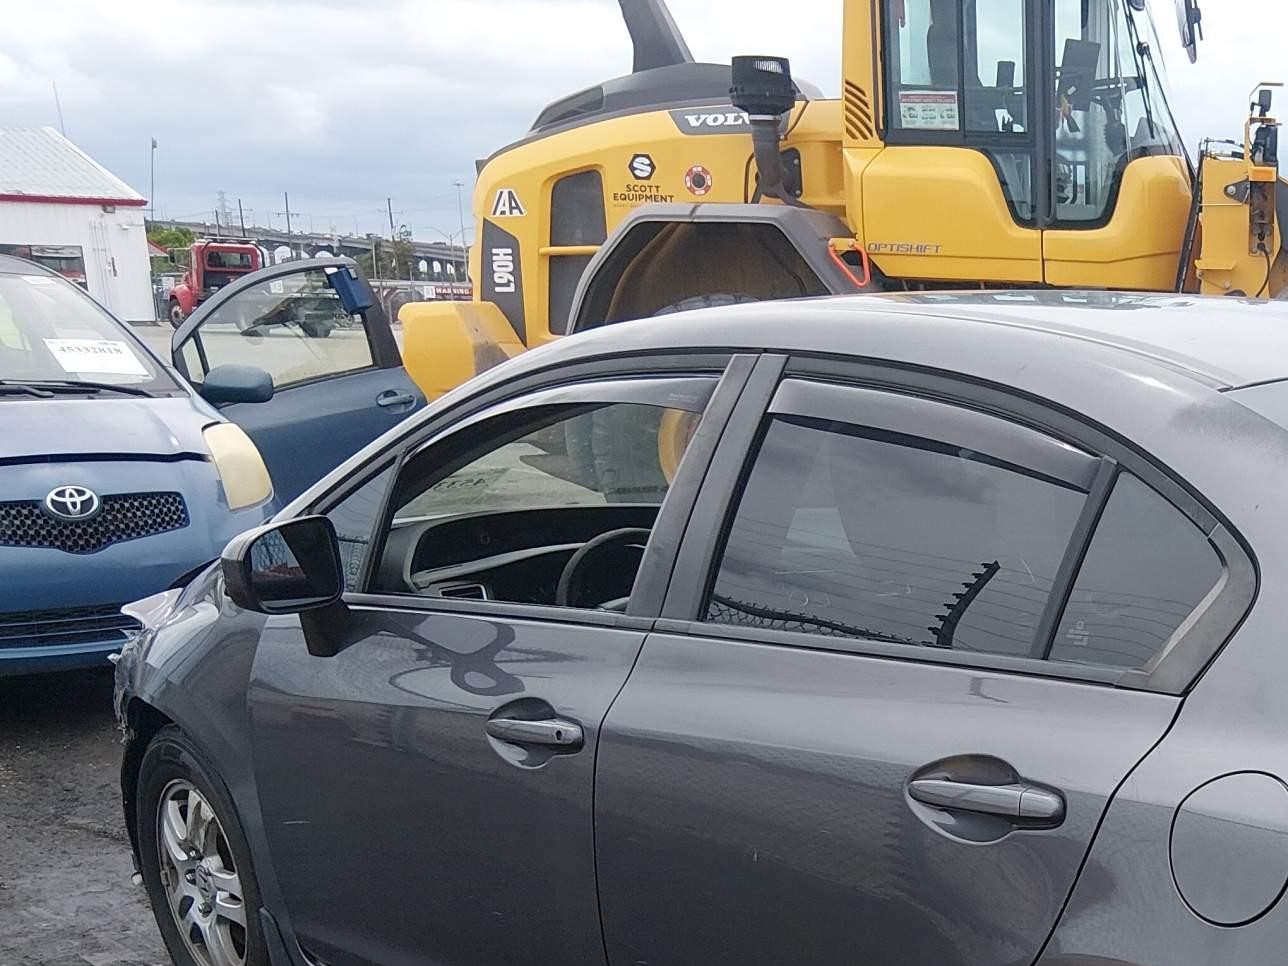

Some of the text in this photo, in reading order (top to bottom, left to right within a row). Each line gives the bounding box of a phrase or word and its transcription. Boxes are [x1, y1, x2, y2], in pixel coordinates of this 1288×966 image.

[685, 113, 750, 126] VOL
[626, 184, 660, 193] SCOTT
[613, 193, 674, 203] EQUIPMENT
[868, 243, 942, 253] OPTISHIFT
[492, 248, 515, 292] L90H
